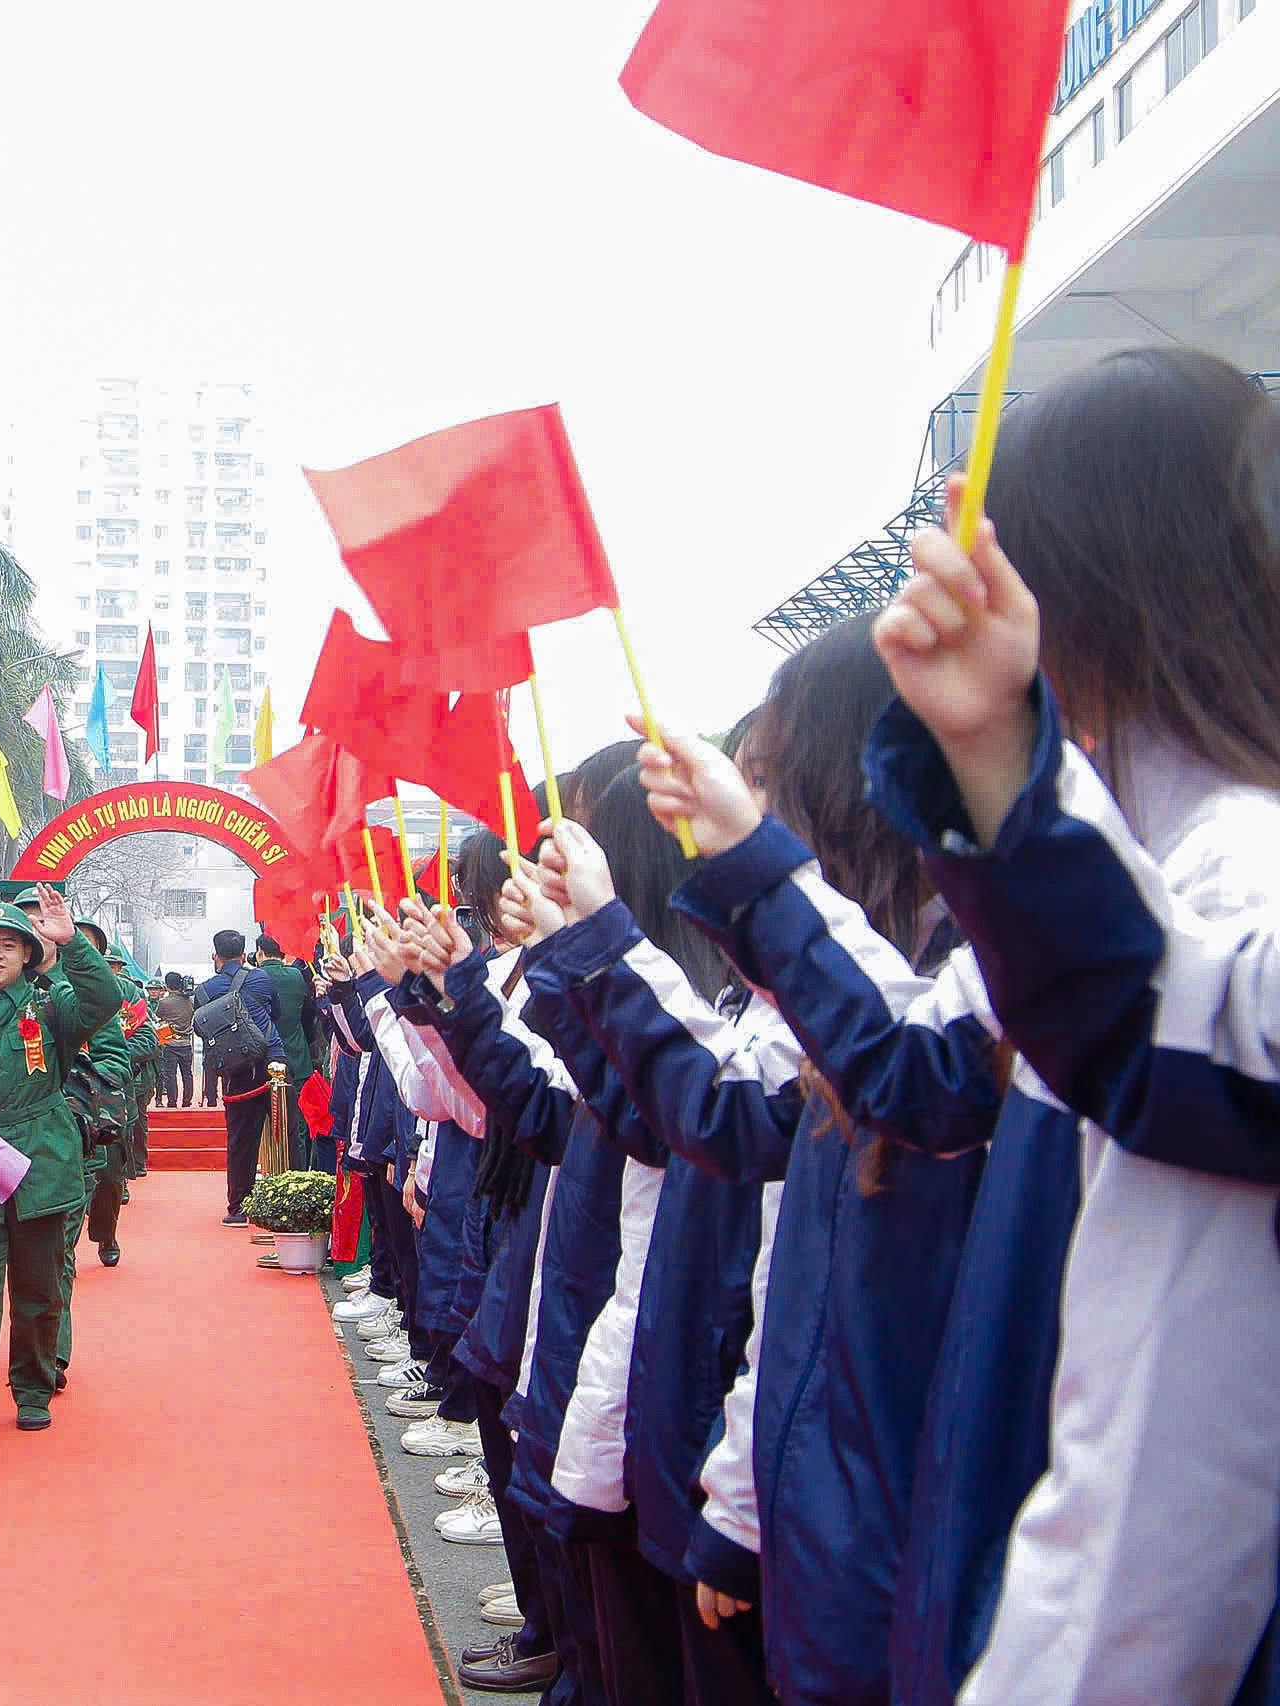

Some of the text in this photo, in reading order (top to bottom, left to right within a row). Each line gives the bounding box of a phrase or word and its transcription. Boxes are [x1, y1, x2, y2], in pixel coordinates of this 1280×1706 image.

[36, 792, 290, 870] VINH DỰ, TỰ HÀO LÀ NGƯỜI CHIẾN SĨ
